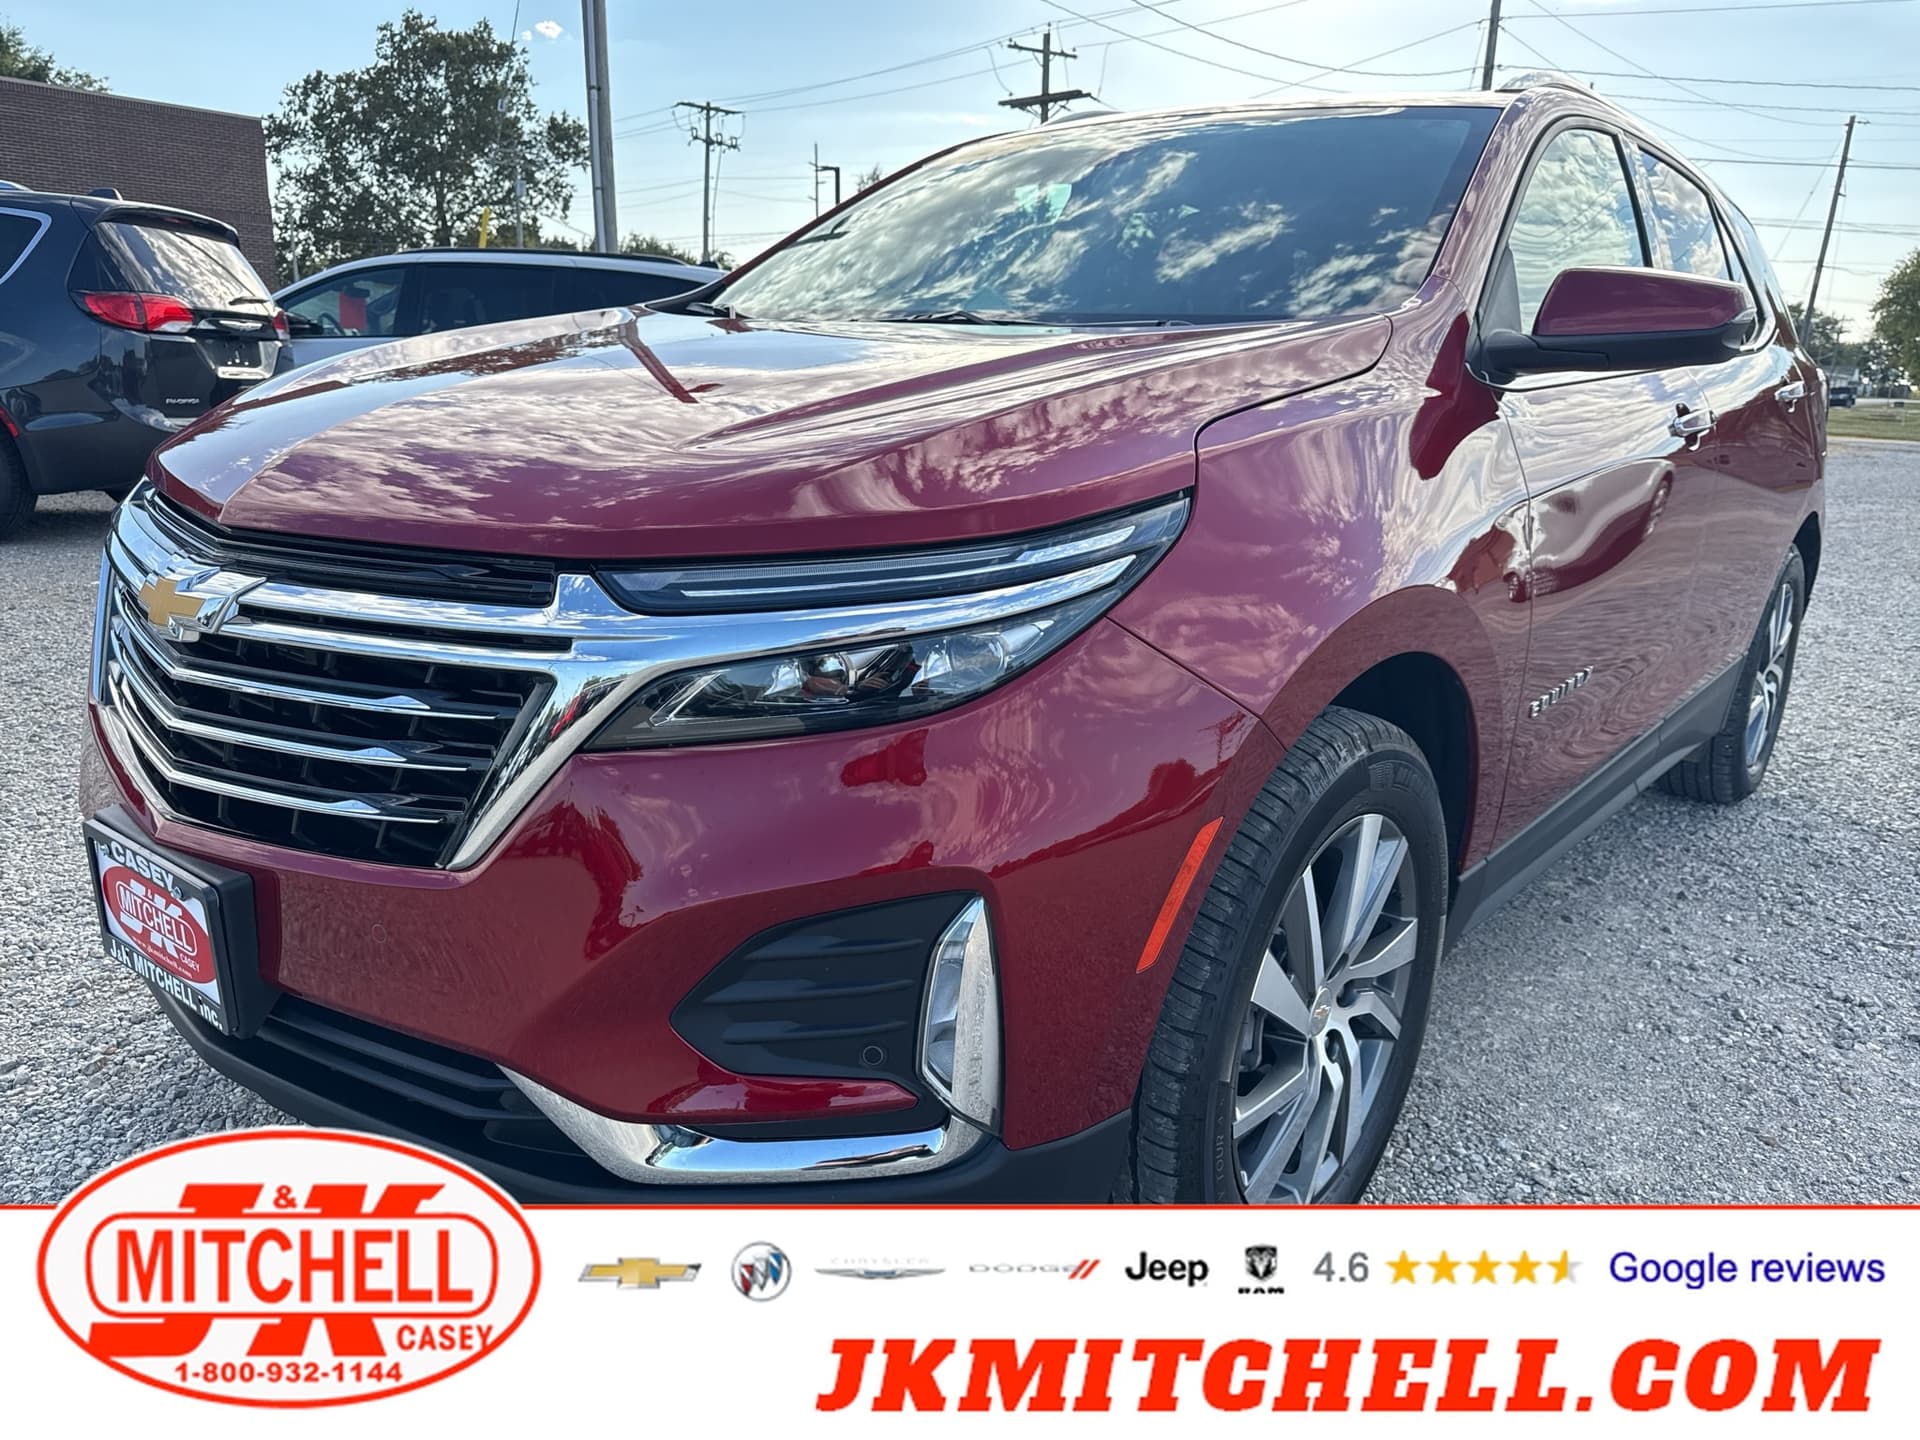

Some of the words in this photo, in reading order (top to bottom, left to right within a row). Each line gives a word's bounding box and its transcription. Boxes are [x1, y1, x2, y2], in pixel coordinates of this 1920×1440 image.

[110, 840, 175, 892] CASEY
[118, 885, 194, 952] MITCHELL
[132, 951, 198, 1012] MITCHELL
